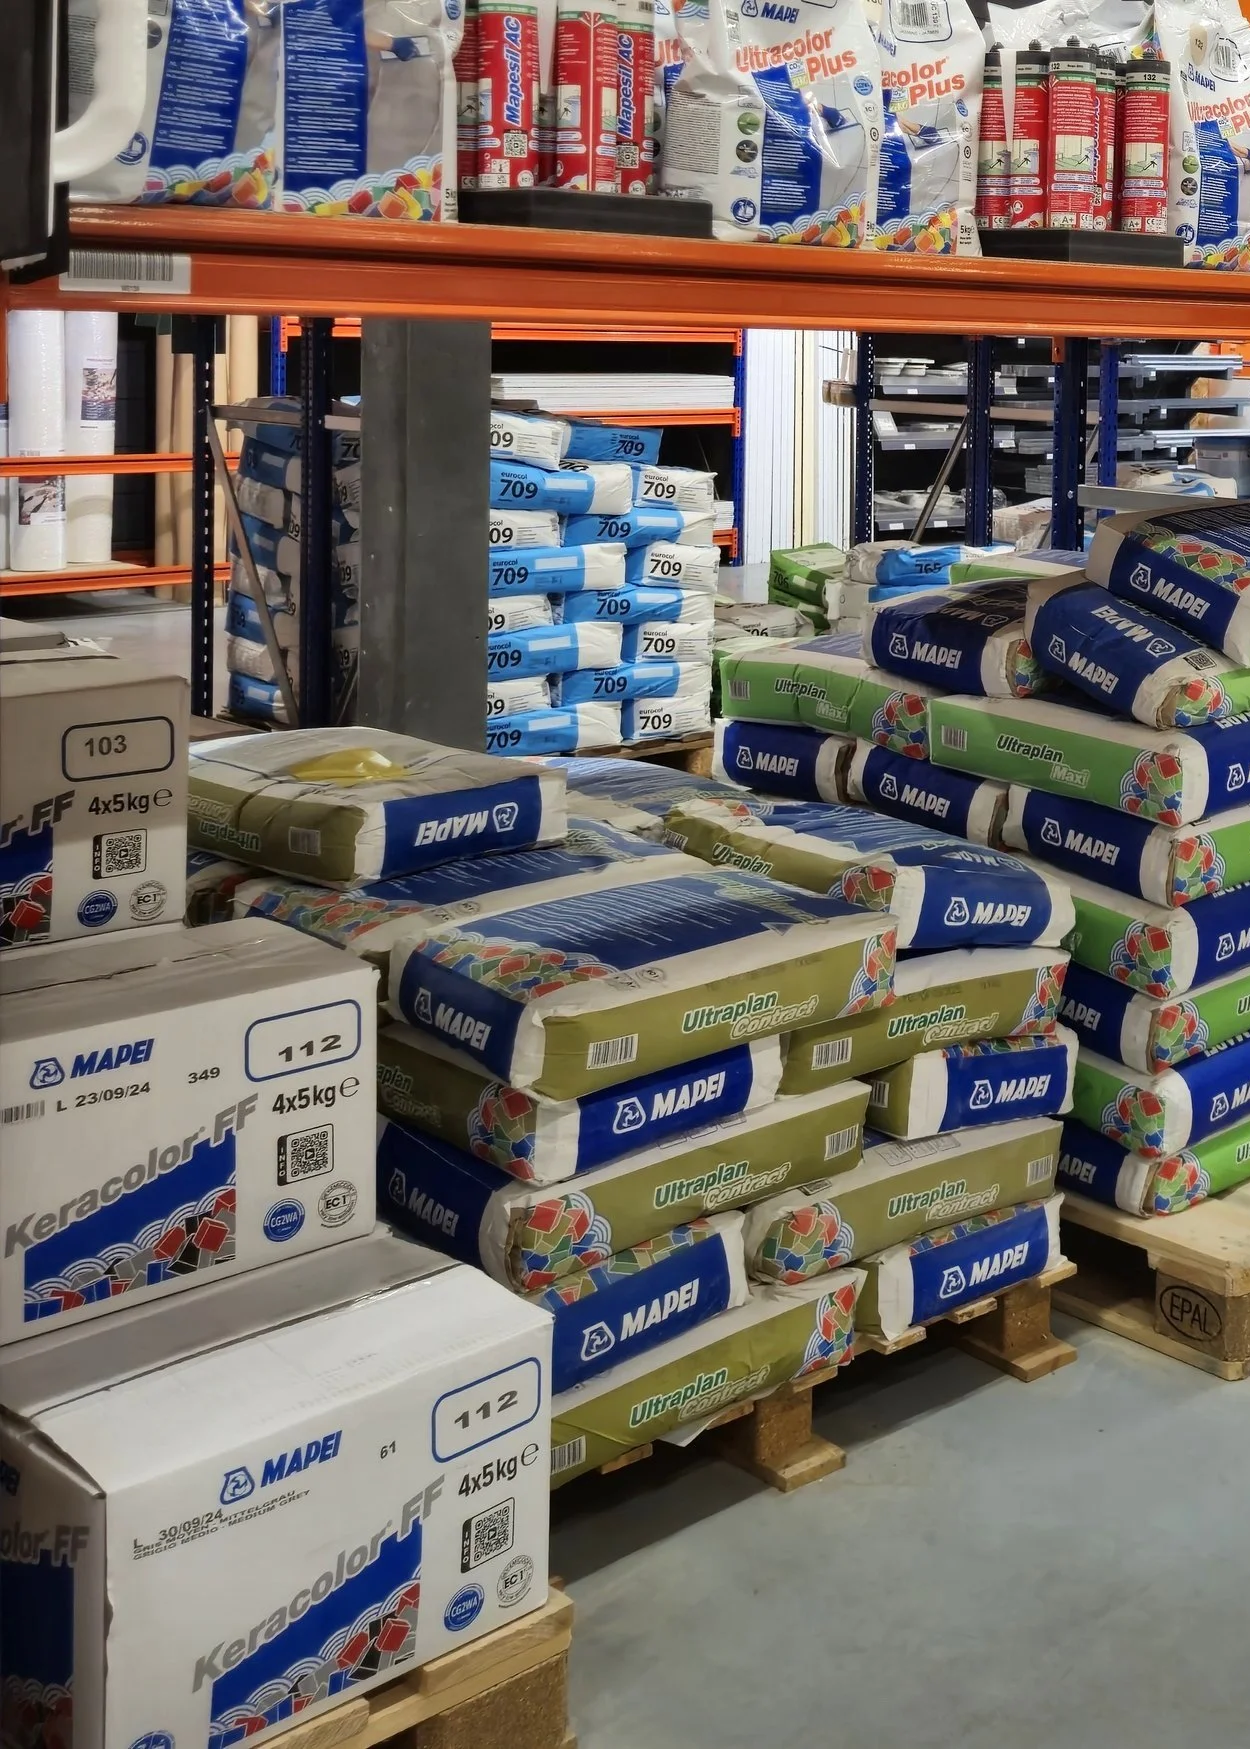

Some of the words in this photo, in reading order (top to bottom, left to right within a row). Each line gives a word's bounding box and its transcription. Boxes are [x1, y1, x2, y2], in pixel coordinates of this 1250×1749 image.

[761, 4, 800, 24] MAPEI
[504, 16, 522, 50] AC
[617, 34, 634, 66] AC
[735, 28, 834, 73] Ultracolor
[807, 48, 857, 82] Plus
[503, 45, 522, 127] Mapesil
[908, 74, 965, 105] Plus
[1195, 71, 1216, 92] MAPEI
[616, 65, 634, 139] Mapesil
[1062, 216, 1075, 225] A+
[1128, 220, 1140, 229] A+
[615, 440, 645, 456] 709
[499, 479, 539, 499] 709
[501, 471, 528, 480] eurocol
[643, 481, 676, 499] 709
[644, 473, 669, 482] eurocol
[597, 521, 631, 538] 709
[493, 559, 518, 567] eurocol
[650, 551, 675, 559] eurocol
[650, 559, 682, 577] 709
[492, 566, 529, 586] 709
[773, 571, 790, 588] 706
[596, 599, 631, 615] 709
[1152, 577, 1210, 620] MAPEI
[1091, 604, 1152, 643] MAPEI
[488, 650, 522, 669] 709
[643, 638, 676, 653] 709
[911, 641, 963, 672] MAPEI
[593, 677, 628, 694] 709
[774, 676, 828, 701] Ultraplan
[1067, 651, 1120, 694] MAPEI
[639, 714, 673, 731] 709
[816, 700, 850, 723] Maxi
[84, 734, 128, 758] 103
[487, 730, 522, 750] 709
[996, 734, 1064, 763] Ultraplan
[755, 751, 800, 778] MAPEI
[1051, 763, 1090, 788] Maxi
[29, 789, 76, 833] FF
[88, 791, 150, 817] 4x5kg
[900, 784, 951, 819] MAPEI
[200, 819, 261, 850] Ultraplan
[415, 810, 489, 847] MAPEI
[711, 842, 773, 876] Ultraplan
[1063, 828, 1119, 866] MAPEI
[971, 901, 1032, 928] MAPEI
[434, 1003, 491, 1052] MAPEI
[682, 991, 778, 1034] Ultraplan
[731, 995, 819, 1039] Contract
[888, 1005, 966, 1039] Ultraplan
[923, 1012, 999, 1046] Contract
[70, 1038, 155, 1079] MAPEI
[278, 1034, 342, 1063] 112
[188, 1067, 221, 1084] 349
[995, 1074, 1051, 1104] MAPEI
[56, 1100, 67, 1113] L
[75, 1082, 152, 1108] 23/09/24
[272, 1083, 336, 1116] 4x5kg
[650, 1072, 726, 1122] MAPEI
[4, 1131, 200, 1258] Keracolor
[212, 1093, 259, 1145] FF
[654, 1160, 750, 1209] Ultraplan
[705, 1162, 791, 1209] Contract
[408, 1187, 460, 1238] MAPEI
[888, 1179, 966, 1220] Ultraplan
[927, 1184, 1000, 1221] Contract
[270, 1212, 299, 1228] CG2WA
[969, 1241, 1029, 1286] MAPEI
[620, 1278, 699, 1342] MAPEI
[1169, 1292, 1213, 1337] EPAL
[629, 1367, 728, 1429] Ultraplan
[679, 1365, 772, 1422] Contract
[454, 1389, 519, 1431] 112
[260, 1430, 342, 1487] MAPEI
[380, 1442, 397, 1460] 61
[457, 1455, 518, 1498] 4x5kg
[132, 1542, 177, 1561] GRIGIO
[180, 1526, 219, 1545] MEDIO
[228, 1506, 276, 1527] MEDIUM
[278, 1489, 311, 1507] GREY
[133, 1541, 162, 1555] GRIS
[165, 1524, 209, 1544] MOYEN
[219, 1490, 297, 1523] MITTELGRAU
[133, 1538, 143, 1549] L
[158, 1508, 224, 1541] 30/09/24
[54, 1525, 91, 1563] FF
[192, 1529, 388, 1693] Keracolor
[400, 1474, 446, 1541] FF
[450, 1597, 479, 1619] CG2WA
